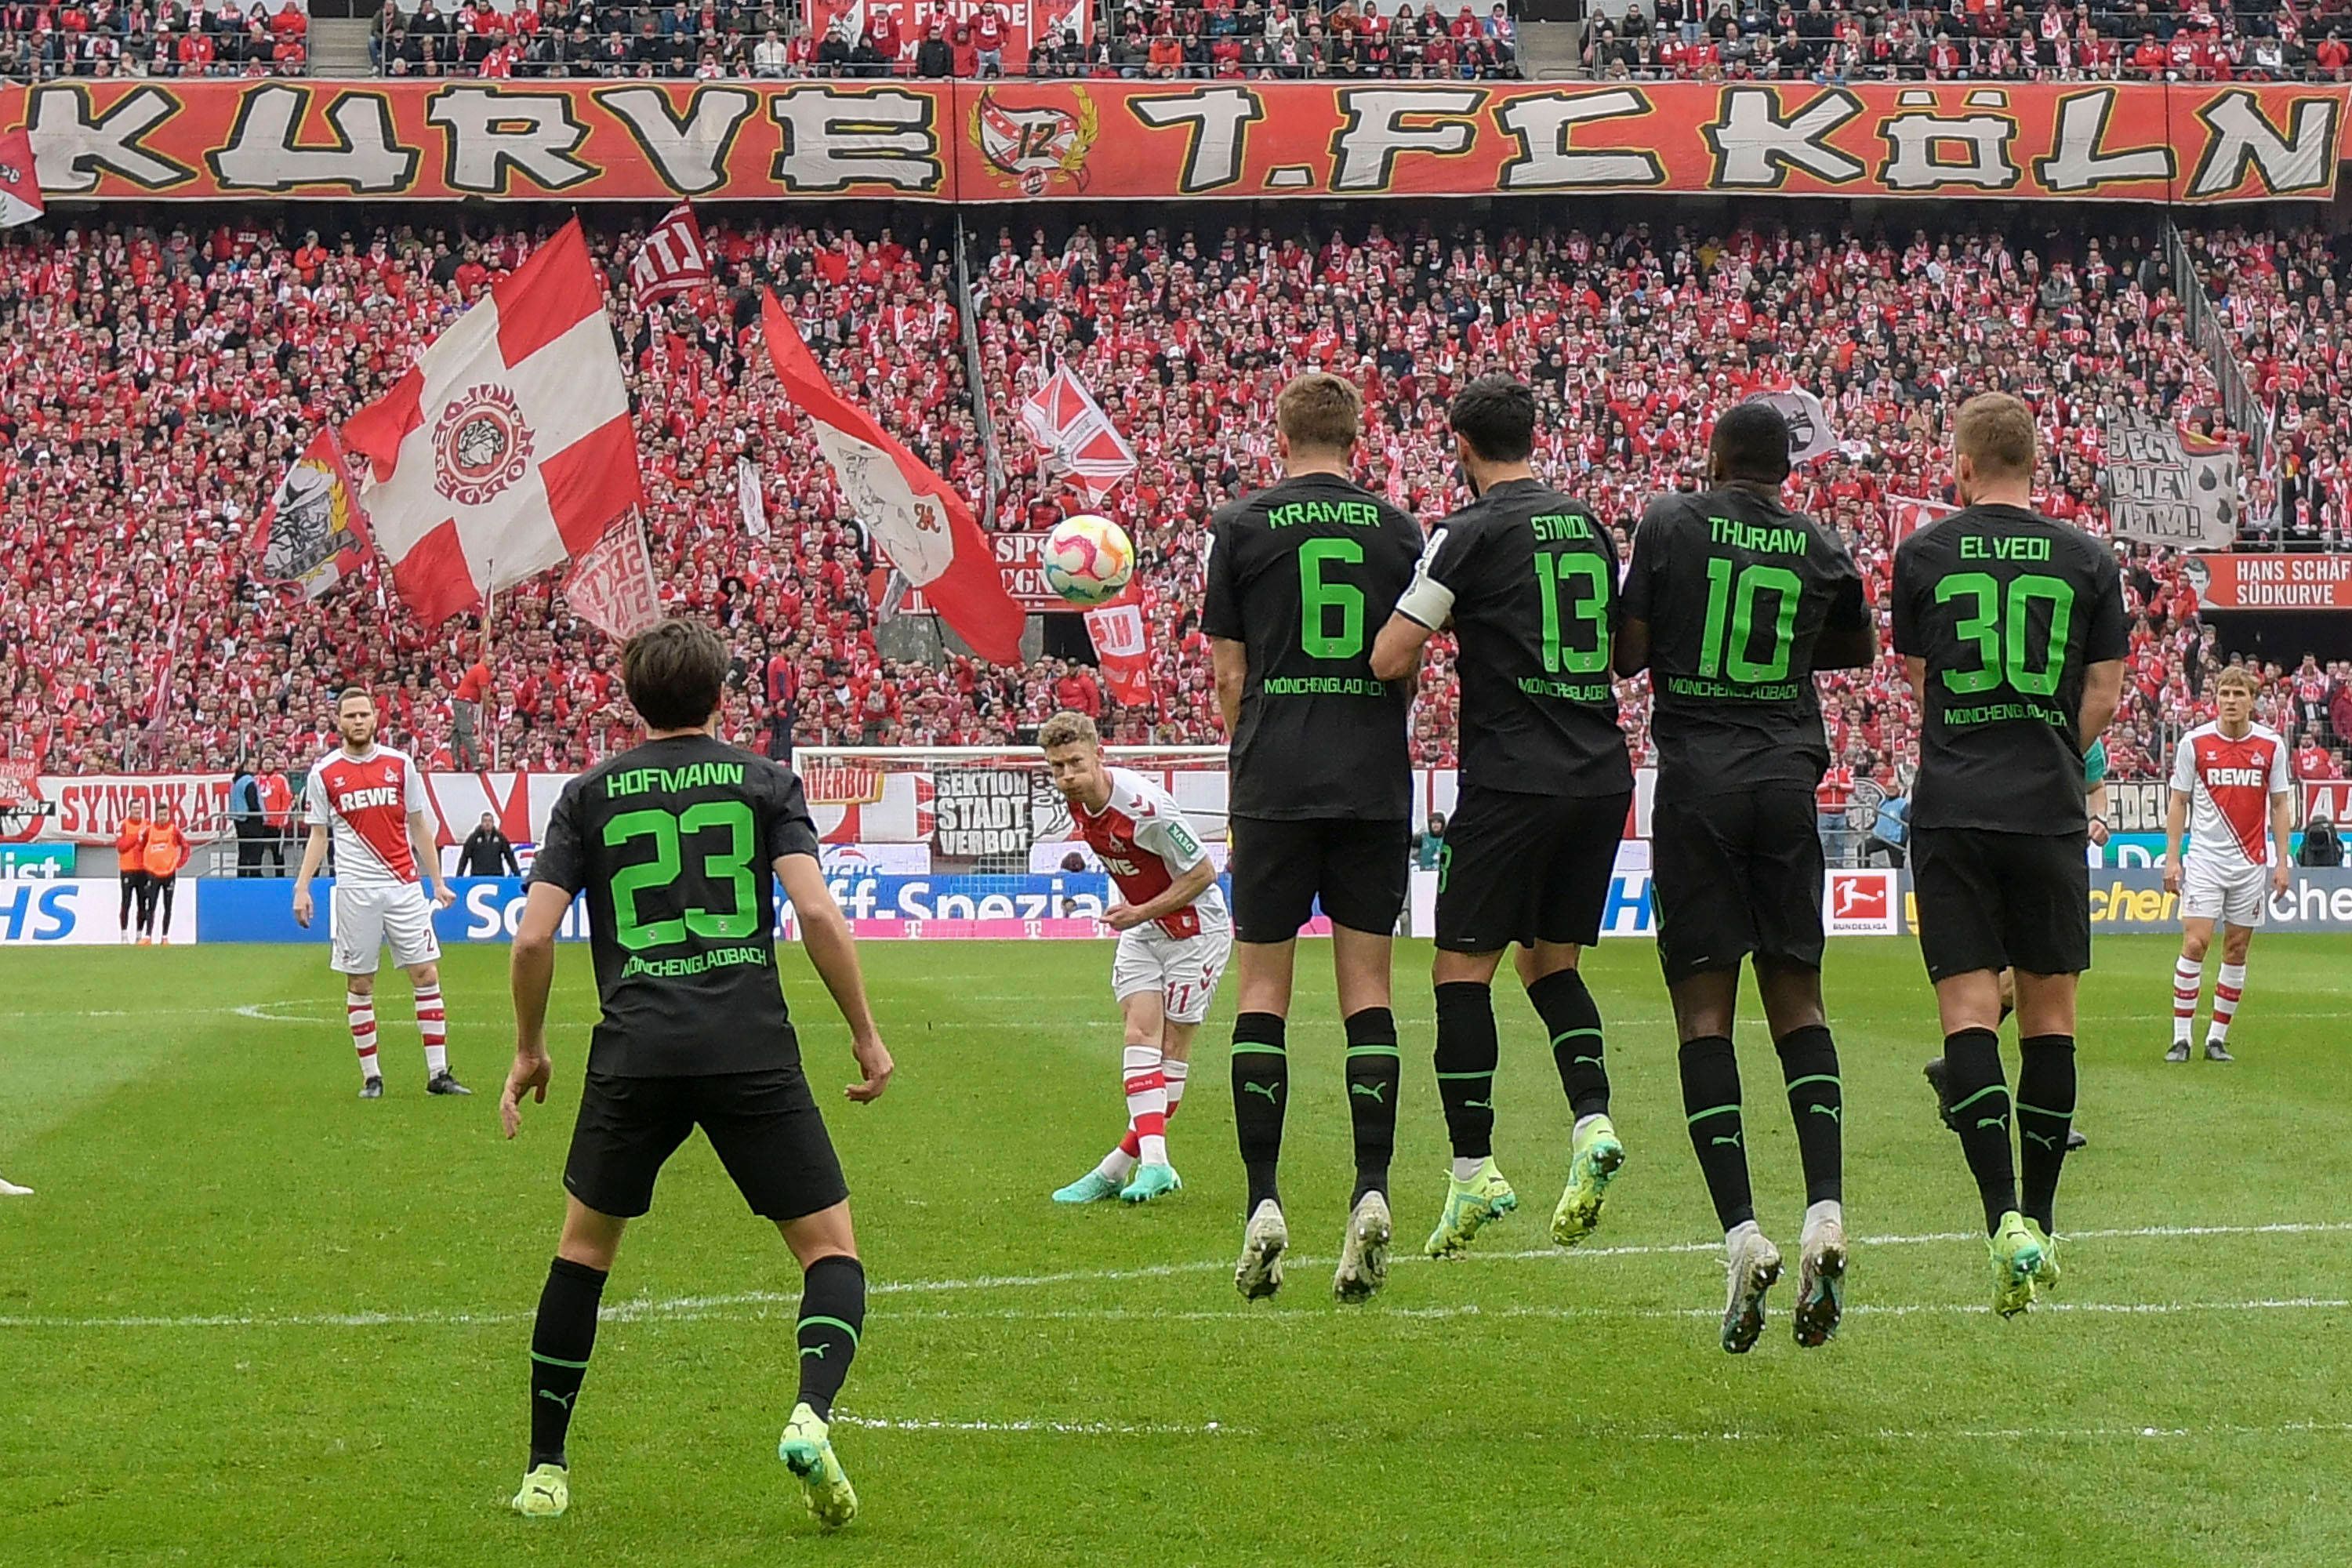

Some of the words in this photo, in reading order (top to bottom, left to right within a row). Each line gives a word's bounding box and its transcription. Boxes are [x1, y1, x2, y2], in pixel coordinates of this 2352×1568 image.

[27, 84, 945, 195] KURVE
[1018, 122, 1057, 158] 12
[1696, 85, 2341, 200] KÖLN
[1268, 502, 1381, 529] KRAMER
[1530, 515, 1595, 541] STINDL
[1708, 517, 1806, 556] THURAM
[1961, 536, 2051, 562] ELVEDI
[2236, 560, 2285, 581] HANS
[1298, 538, 1364, 659] 6
[2236, 579, 2335, 604] SÜDKURVE
[1534, 552, 1610, 673] 13
[1698, 557, 1802, 684] 10
[1934, 572, 2075, 697] 30
[606, 763, 744, 798] HOFMANN
[937, 771, 1029, 797] SEKTION
[2205, 768, 2263, 787] REWE
[60, 782, 233, 833] SYNDIKAT
[339, 786, 398, 813] REWE
[938, 796, 1029, 830] STADT
[938, 829, 1029, 855] VERBOT
[1170, 825, 1196, 853] DEVK
[603, 800, 759, 951] 23
[423, 929, 434, 952] 2
[1166, 981, 1191, 1014] 11
